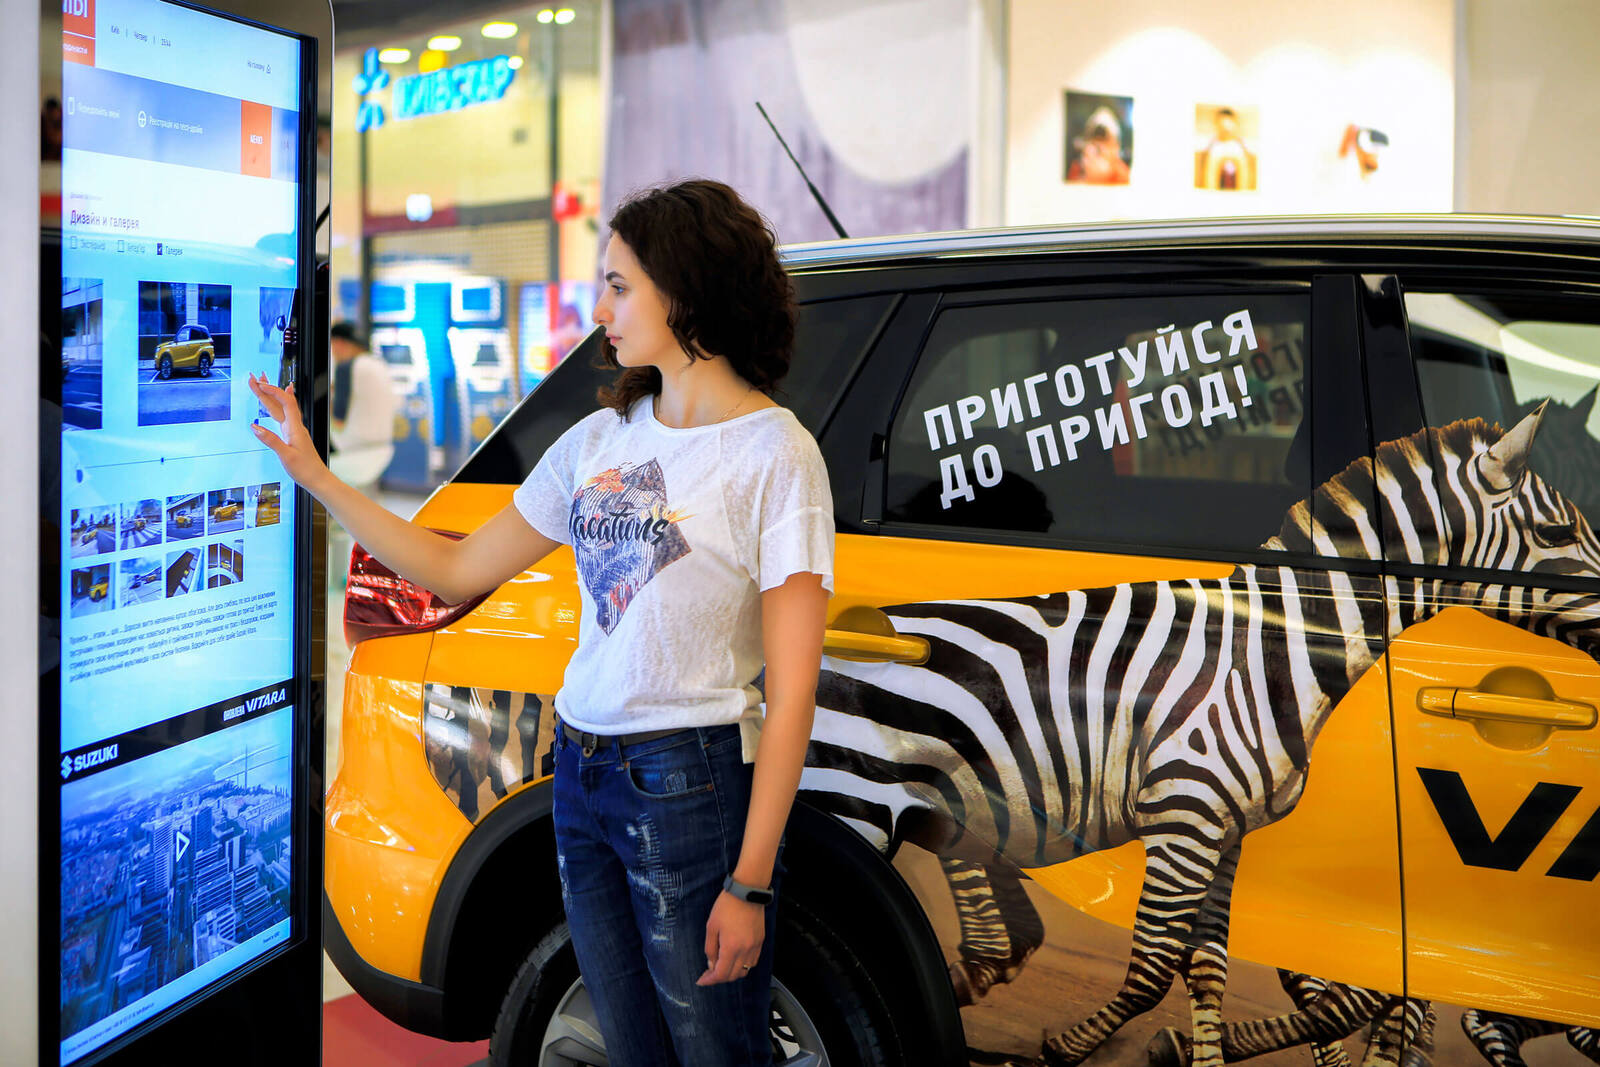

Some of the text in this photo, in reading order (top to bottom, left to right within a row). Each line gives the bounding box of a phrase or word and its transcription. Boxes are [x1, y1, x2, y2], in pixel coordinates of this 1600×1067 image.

[70, 209, 100, 225] Дизайн
[109, 216, 140, 230] галерея
[923, 309, 1258, 451] ПРИГОТУЙСЯ
[939, 444, 1003, 510] ДО
[1025, 365, 1253, 472] ПРИГОД!
[245, 688, 287, 713] VITARA
[73, 743, 119, 772] SUZUKI
